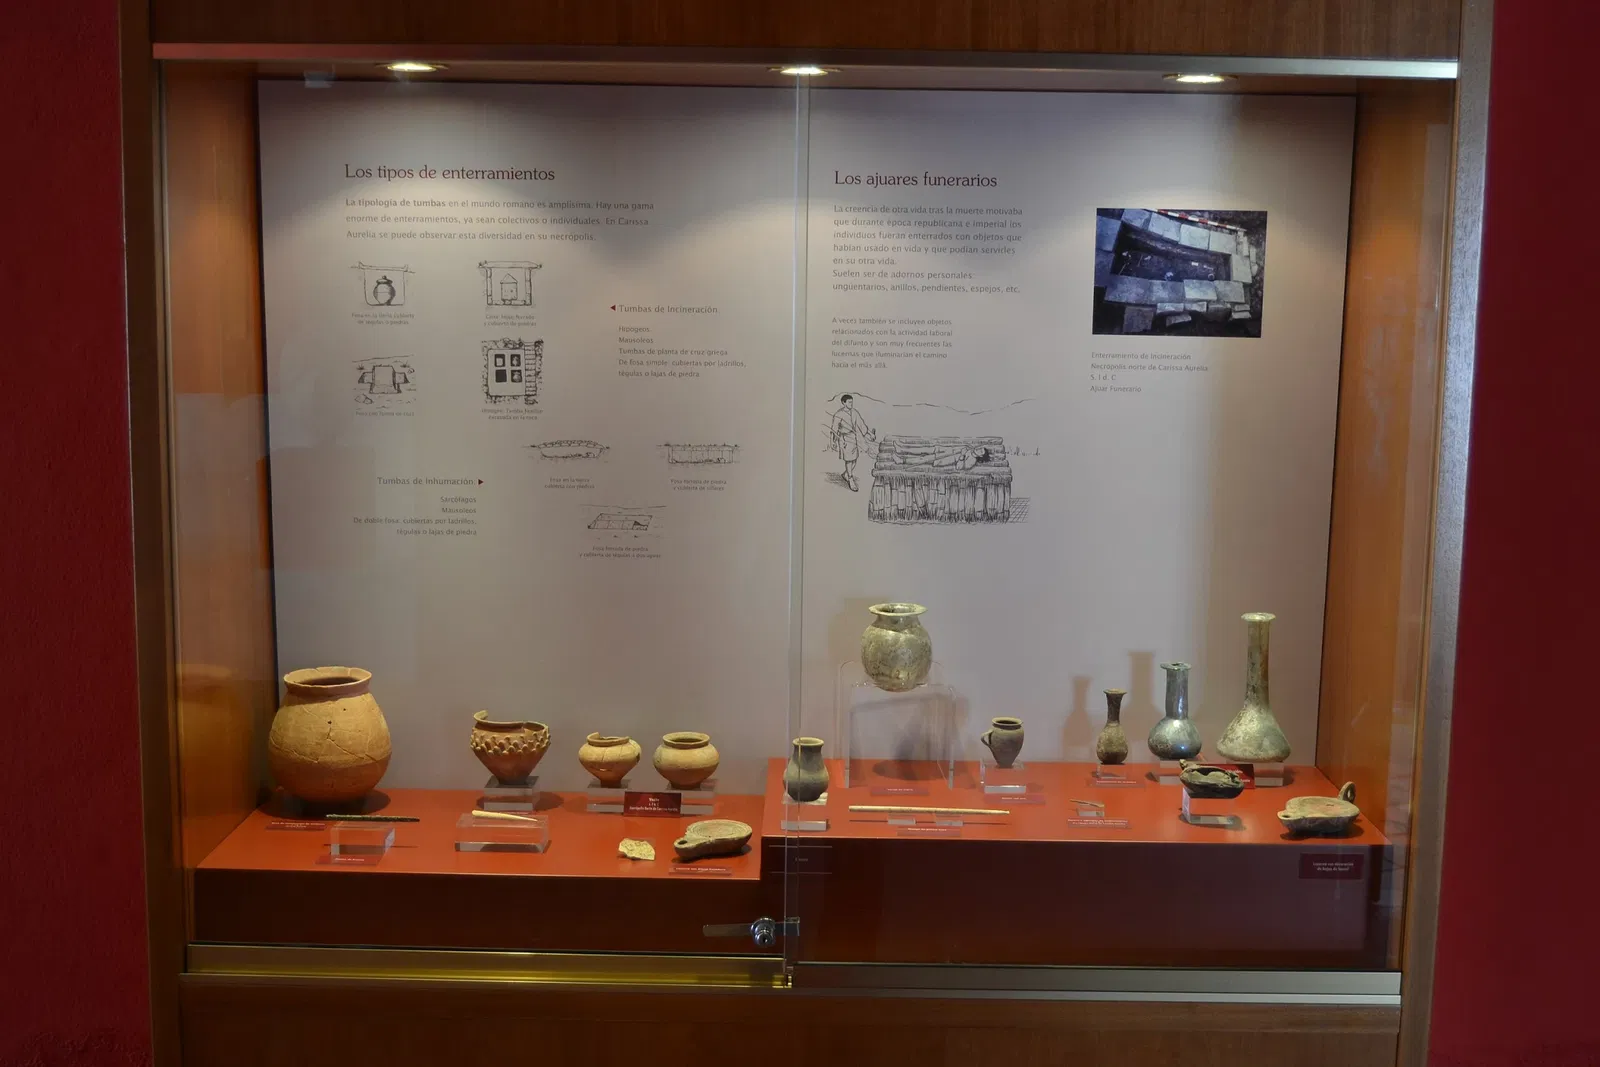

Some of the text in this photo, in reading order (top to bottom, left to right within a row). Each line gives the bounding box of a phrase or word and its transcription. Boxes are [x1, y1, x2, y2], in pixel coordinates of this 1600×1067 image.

[345, 164, 555, 182] Los tipos de enterramientos
[835, 171, 997, 189] Los ajuares funerarios
[358, 198, 398, 208] tipología
[399, 198, 411, 207] de
[596, 201, 612, 210] Hay
[880, 205, 890, 213] de
[910, 206, 928, 214] vida
[946, 206, 953, 214] la
[985, 207, 1023, 215] motivaba
[380, 214, 392, 222] de
[498, 216, 540, 224] colectivos
[618, 217, 649, 225] Carissa
[851, 217, 884, 226] durante
[914, 219, 963, 228] republicana
[973, 219, 1007, 228] imperial
[1009, 220, 1022, 228] los
[346, 230, 376, 239] Aurelia
[391, 231, 417, 240] puede
[419, 231, 457, 239] observar
[478, 232, 522, 240] diversidad
[833, 231, 876, 239] individuos
[879, 231, 907, 240] fueran
[908, 232, 953, 240] enterrados
[973, 233, 1004, 242] objetos
[864, 244, 889, 252] usado
[904, 244, 922, 252] vida
[832, 269, 860, 278] Suelen
[877, 270, 888, 278] de
[890, 283, 919, 292] anillos,
[921, 284, 968, 293] pendientes,
